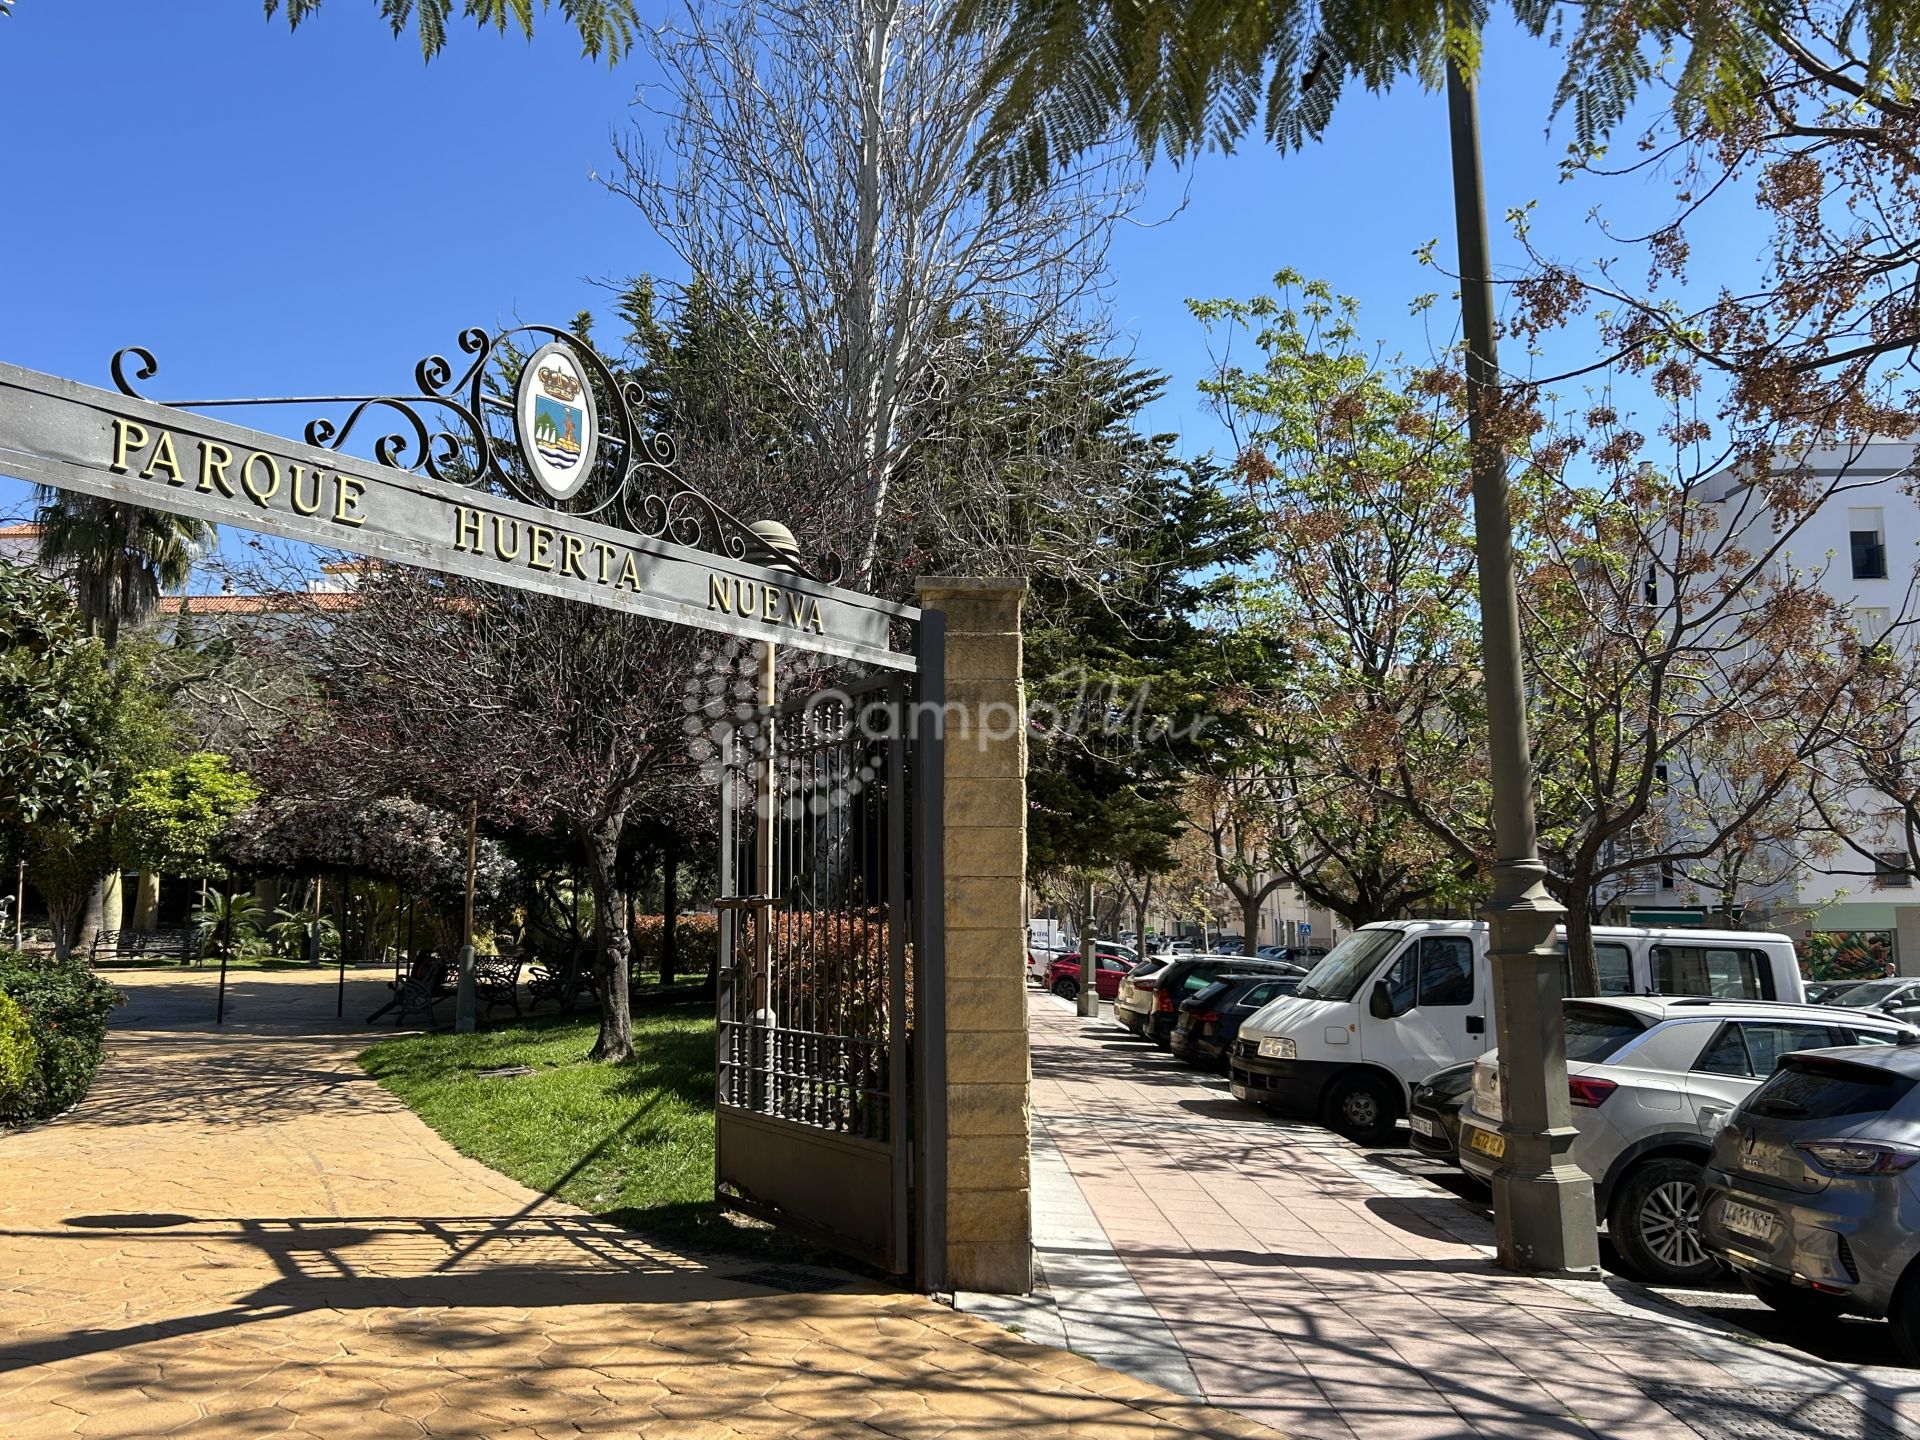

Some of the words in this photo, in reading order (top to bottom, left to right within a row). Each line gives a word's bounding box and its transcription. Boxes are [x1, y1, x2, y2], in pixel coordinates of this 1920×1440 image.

[111, 418, 368, 527] PARQUE
[454, 505, 643, 593] HUERTA
[707, 573, 825, 635] NUEVA
